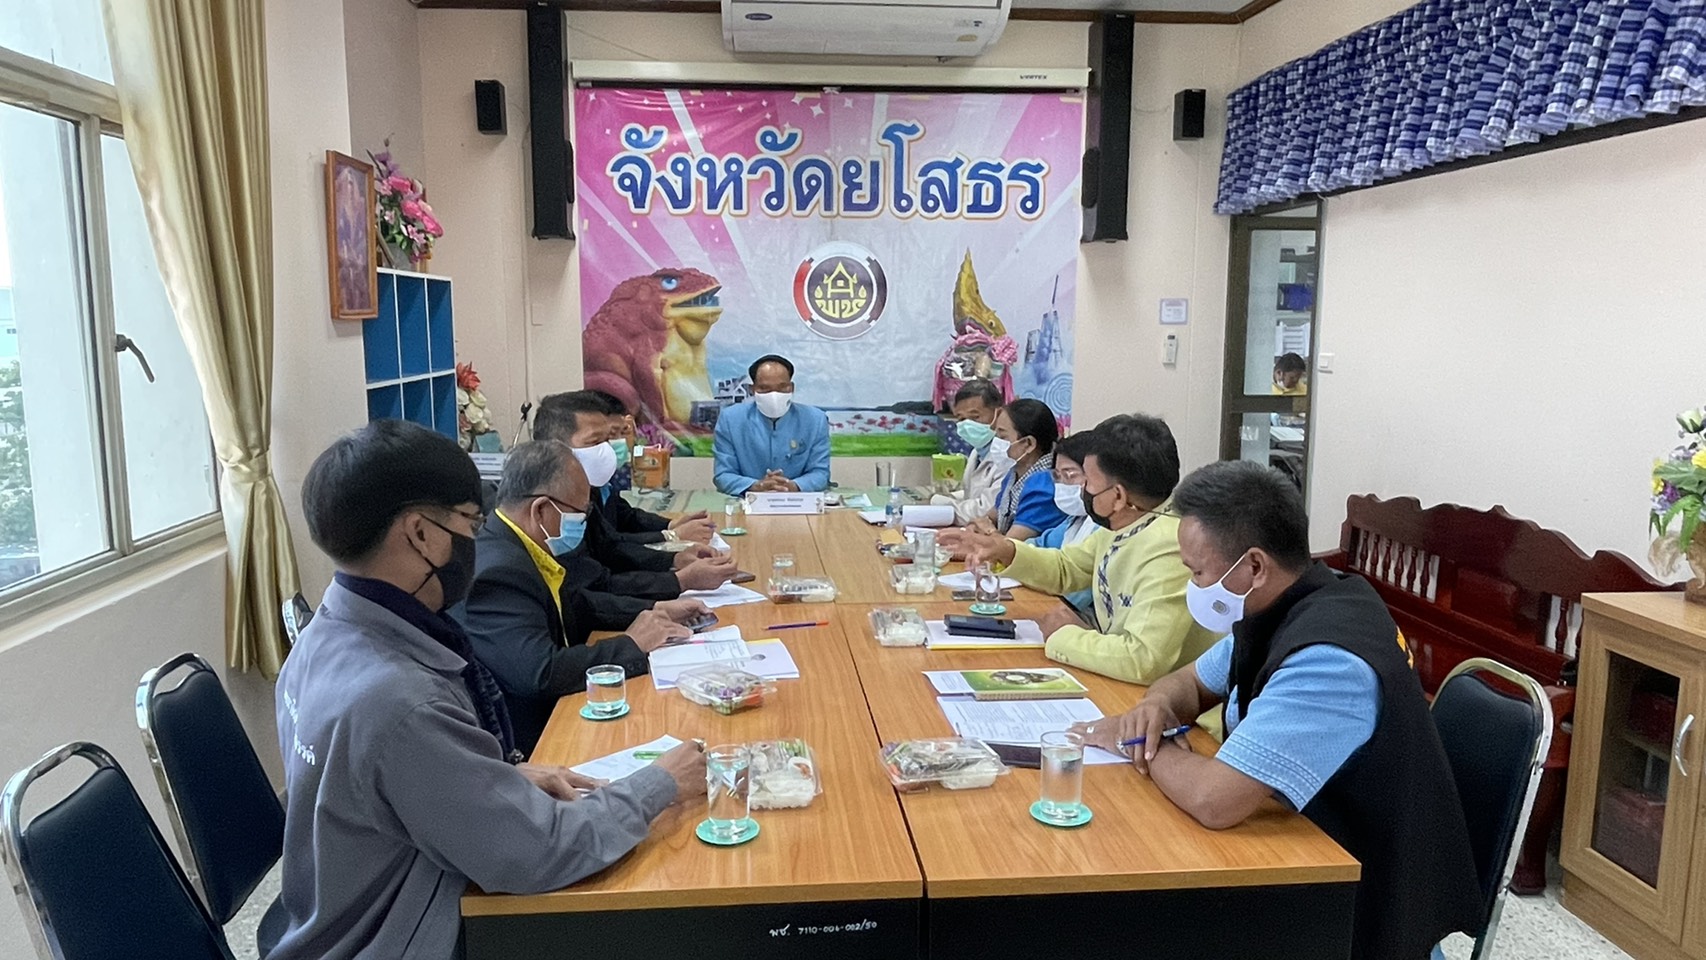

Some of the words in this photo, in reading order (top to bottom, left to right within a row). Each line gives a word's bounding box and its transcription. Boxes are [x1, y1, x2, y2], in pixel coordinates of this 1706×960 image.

[608, 120, 1050, 218] จังหวัดยโสธร
